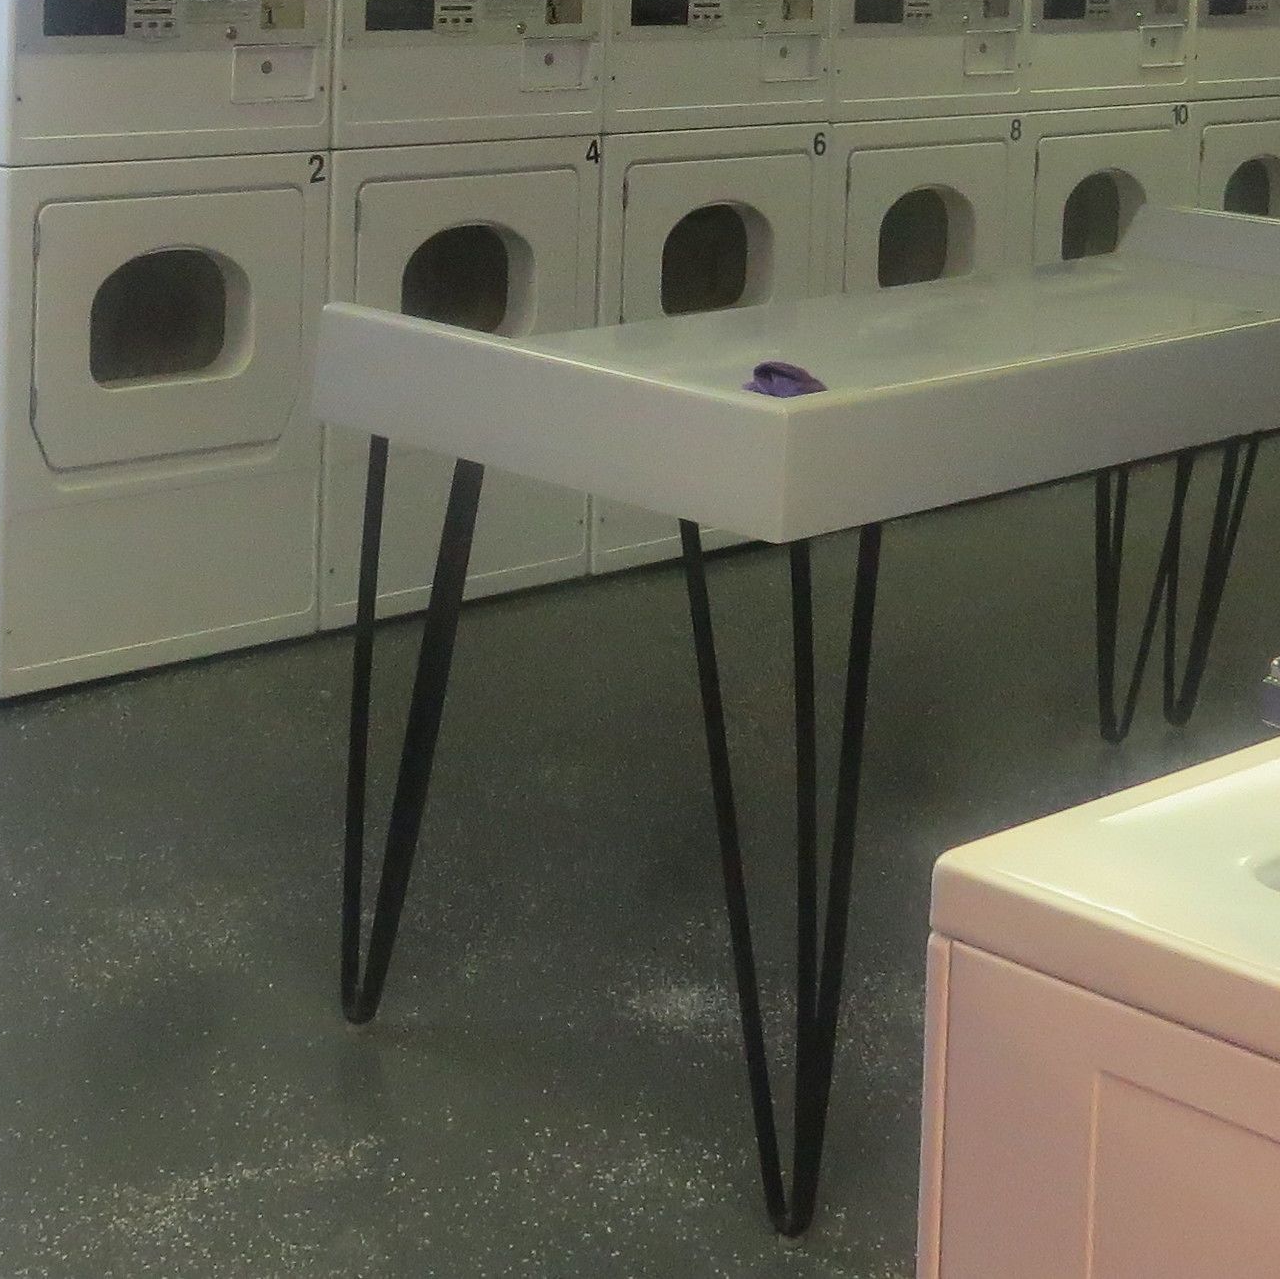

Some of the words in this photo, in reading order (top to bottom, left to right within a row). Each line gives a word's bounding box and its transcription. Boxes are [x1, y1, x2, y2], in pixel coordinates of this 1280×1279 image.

[1171, 104, 1189, 126] 10
[1010, 118, 1023, 142] 8
[585, 138, 602, 164] 4
[813, 131, 827, 157] 6
[308, 154, 327, 184] 2
